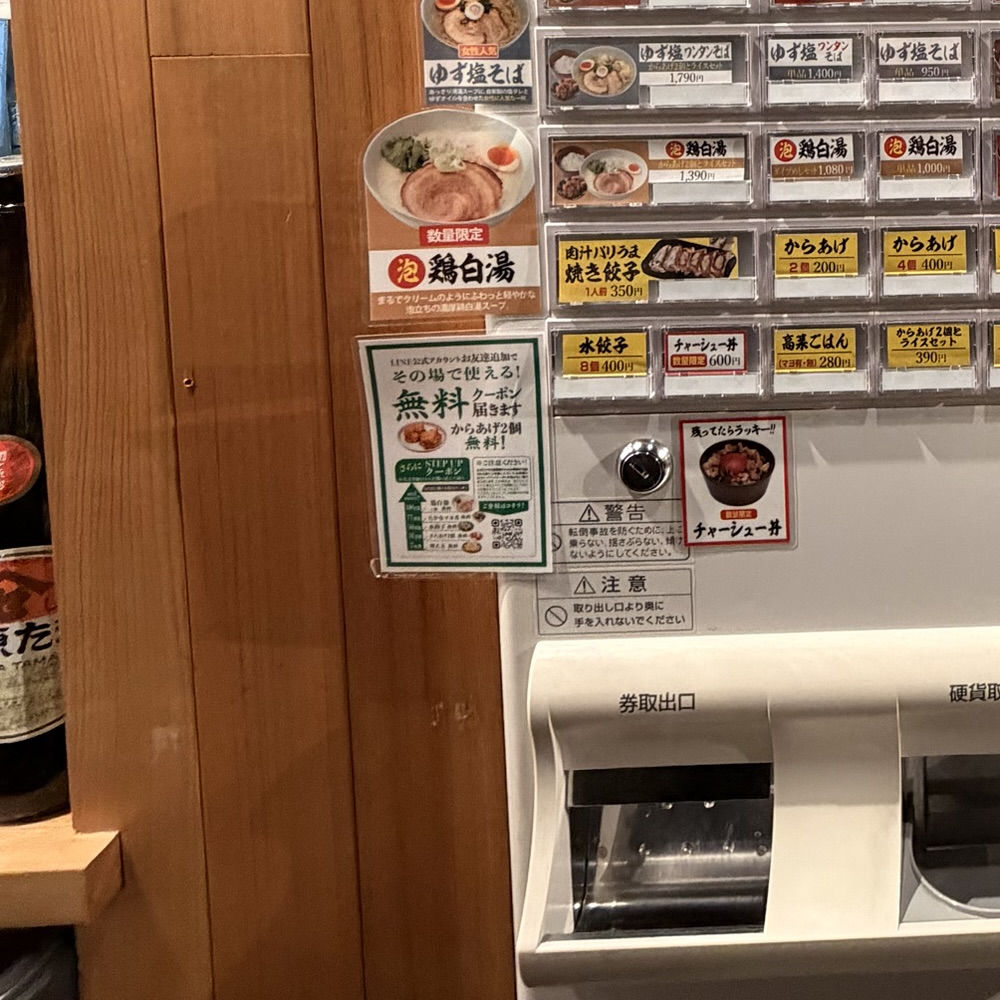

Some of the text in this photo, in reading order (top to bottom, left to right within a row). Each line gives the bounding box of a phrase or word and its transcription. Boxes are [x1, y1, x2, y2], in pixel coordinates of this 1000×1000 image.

[879, 41, 961, 62] ゆず塩そば
[429, 61, 525, 85] ゆず塩そば
[669, 72, 704, 84] 1,790円
[807, 67, 842, 79] 1,400円
[921, 66, 950, 78] 950円
[679, 170, 716, 182] 1,390円
[426, 226, 484, 243] 数量限定
[783, 236, 851, 256] からあげ
[892, 234, 959, 254] からあげ
[565, 245, 642, 260] 肉汁バリうま
[789, 261, 846, 274] 2個 200円
[897, 258, 953, 271] 4個 400円
[564, 261, 642, 284] 焼き餃子
[585, 285, 644, 298] 1人前 350円
[578, 336, 630, 355] 水餃子
[673, 336, 739, 352] チャーシュー丼
[899, 337, 958, 349] ライスセット
[708, 354, 741, 368] 600円
[819, 355, 851, 368] 280円
[915, 350, 947, 364] 390円
[579, 360, 634, 373] 8個 400円
[392, 365, 521, 384] その場で使える!
[392, 386, 522, 421] 無料 クーポン
[472, 402, 522, 418] 届きます
[451, 421, 522, 435] からあげ2個
[464, 435, 506, 451] 無料!
[604, 503, 646, 522] 警告
[693, 518, 783, 540] チャーシュー丼
[569, 548, 674, 560] ないようにしてください。
[601, 574, 648, 594] 注意
[573, 600, 665, 614] 取り出し口より奥に
[574, 613, 687, 628] 手を入れないでください
[618, 693, 696, 714] 券取出口
